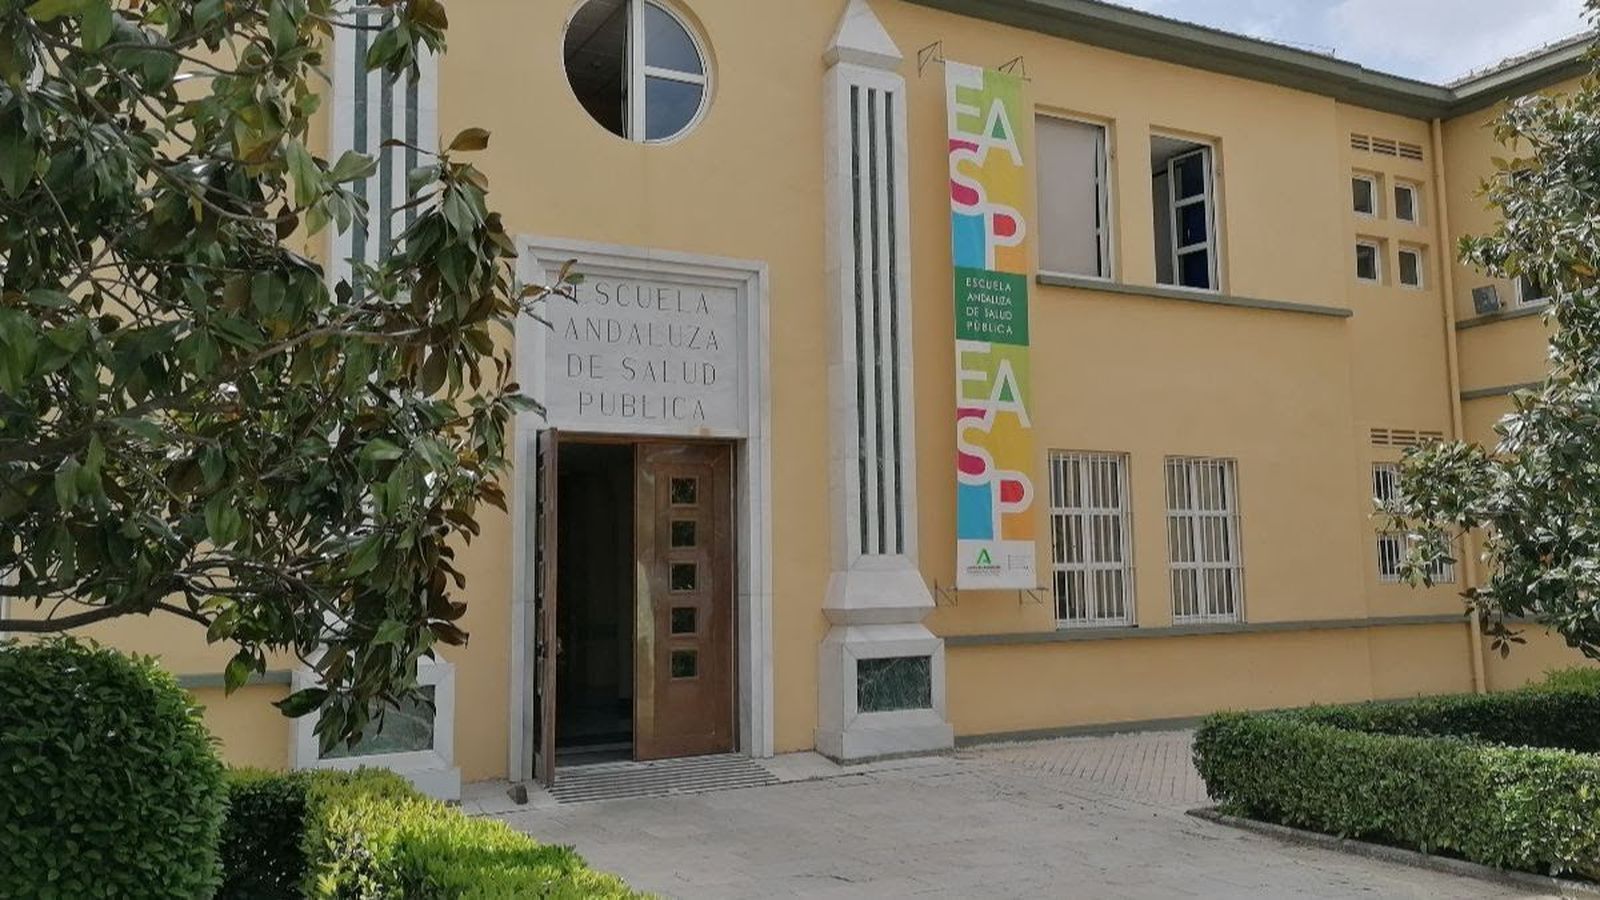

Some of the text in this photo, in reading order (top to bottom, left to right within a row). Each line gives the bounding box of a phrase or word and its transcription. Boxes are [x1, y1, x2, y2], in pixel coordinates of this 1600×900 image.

[966, 277, 1012, 292] ESCUELA
[967, 293, 1012, 306] ANDALUZA
[966, 306, 1013, 321] DE SALUD
[565, 317, 719, 350] ANDALUZA
[567, 353, 717, 386] DE SALUD
[579, 391, 706, 421] PUBLICA
